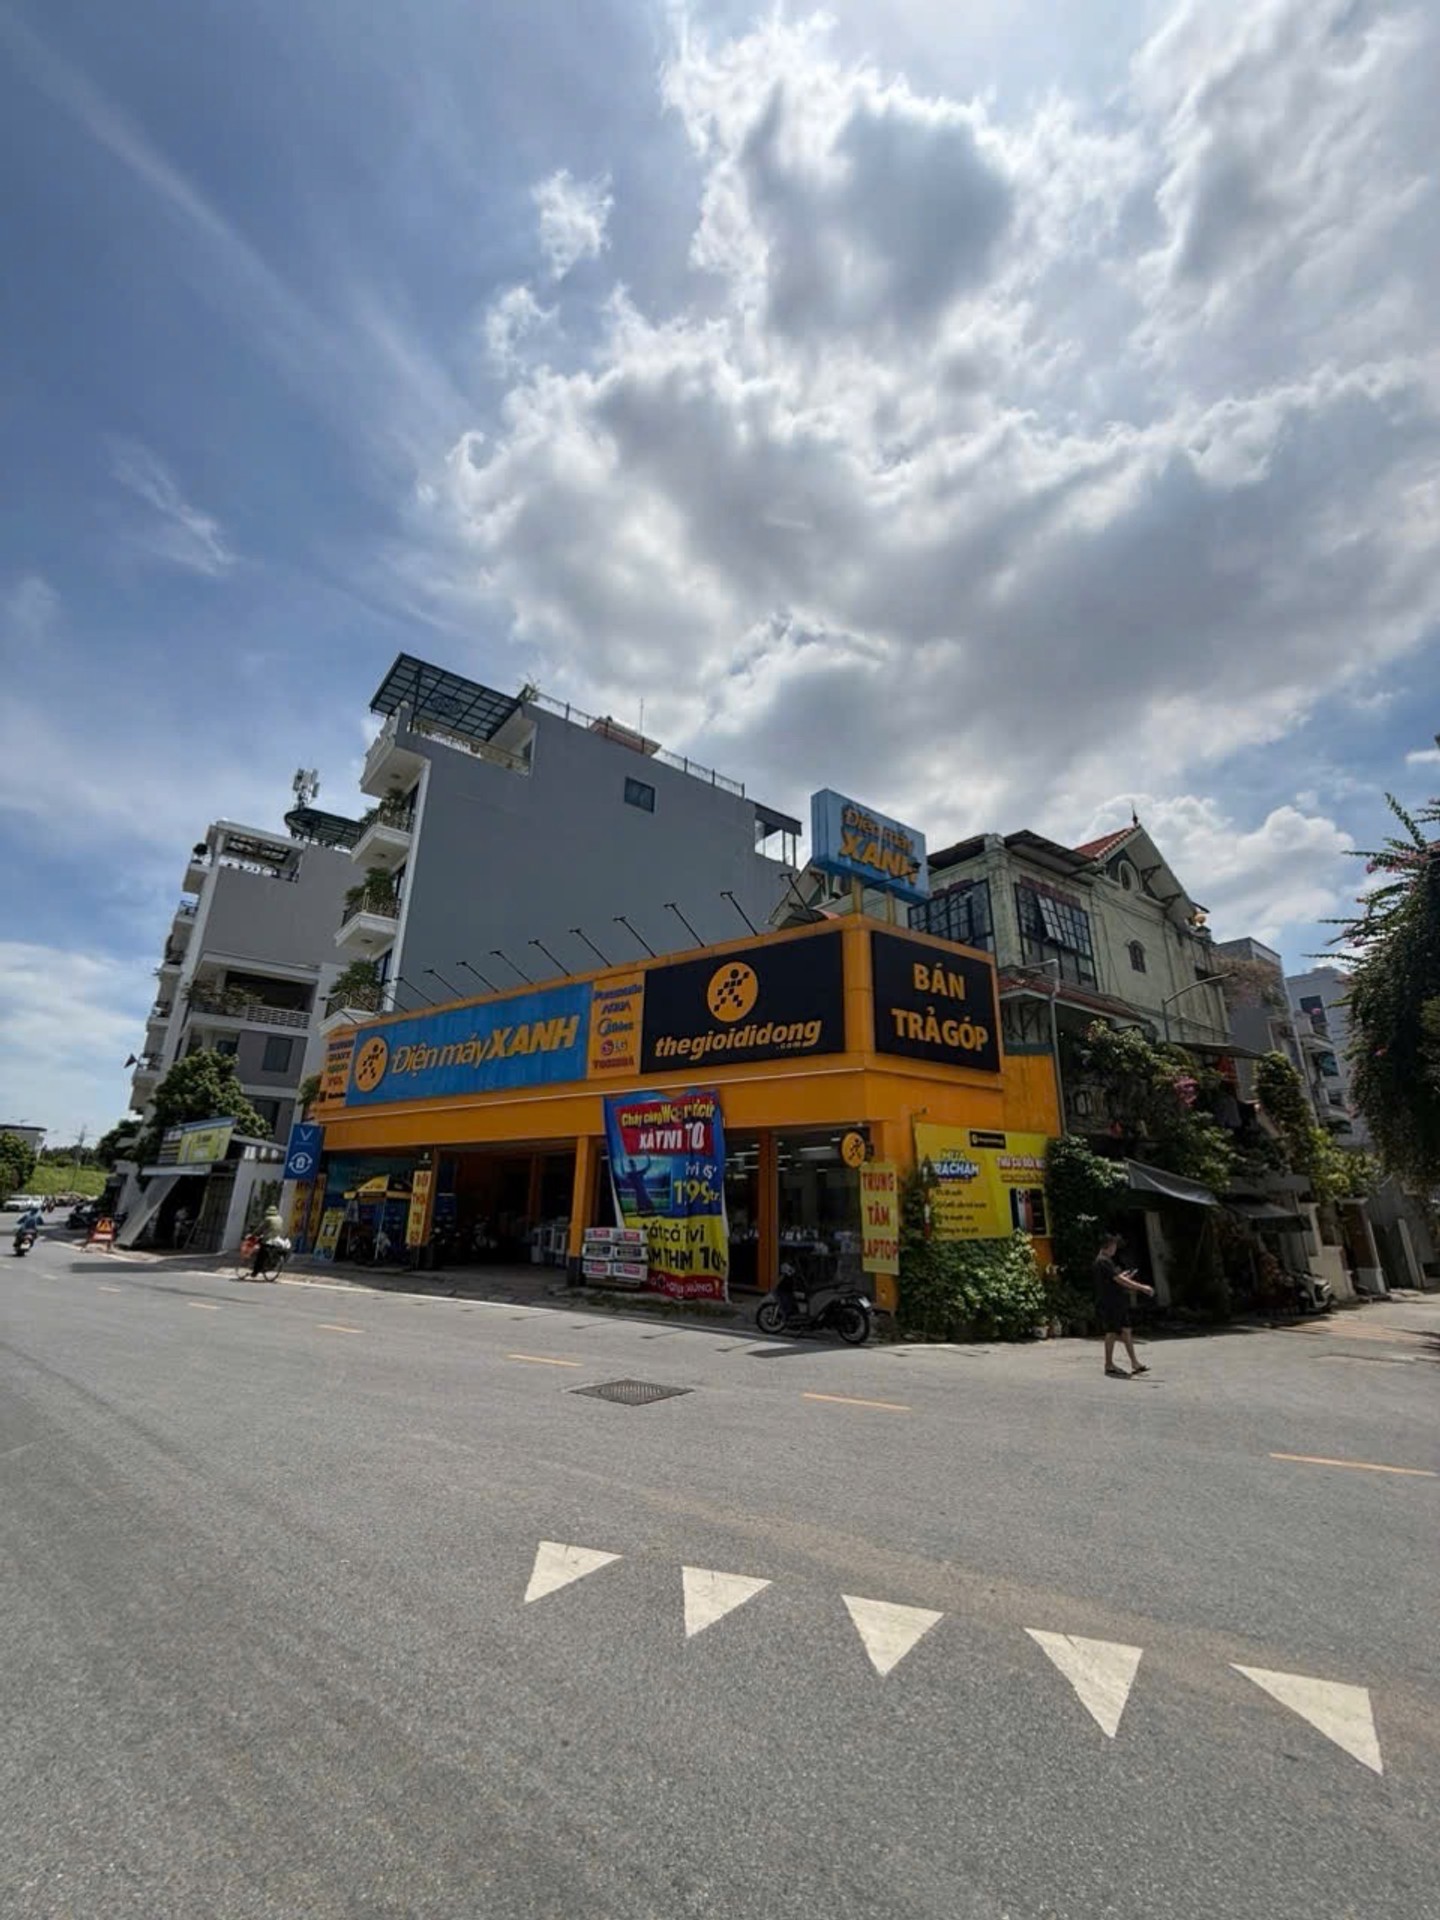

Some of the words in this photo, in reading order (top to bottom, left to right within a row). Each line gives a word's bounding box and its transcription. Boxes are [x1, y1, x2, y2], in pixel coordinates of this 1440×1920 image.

[912, 962, 965, 1001] BÁN
[391, 1041, 439, 1077] Điện
[486, 1015, 580, 1060] XANH
[654, 1020, 823, 1061] thegioididong
[890, 1006, 942, 1044] TRẢ
[941, 1016, 989, 1051] GÓP
[862, 1172, 894, 1192] TRUNG
[867, 1202, 890, 1227] TÂM
[863, 1239, 898, 1260] LAPTOP
